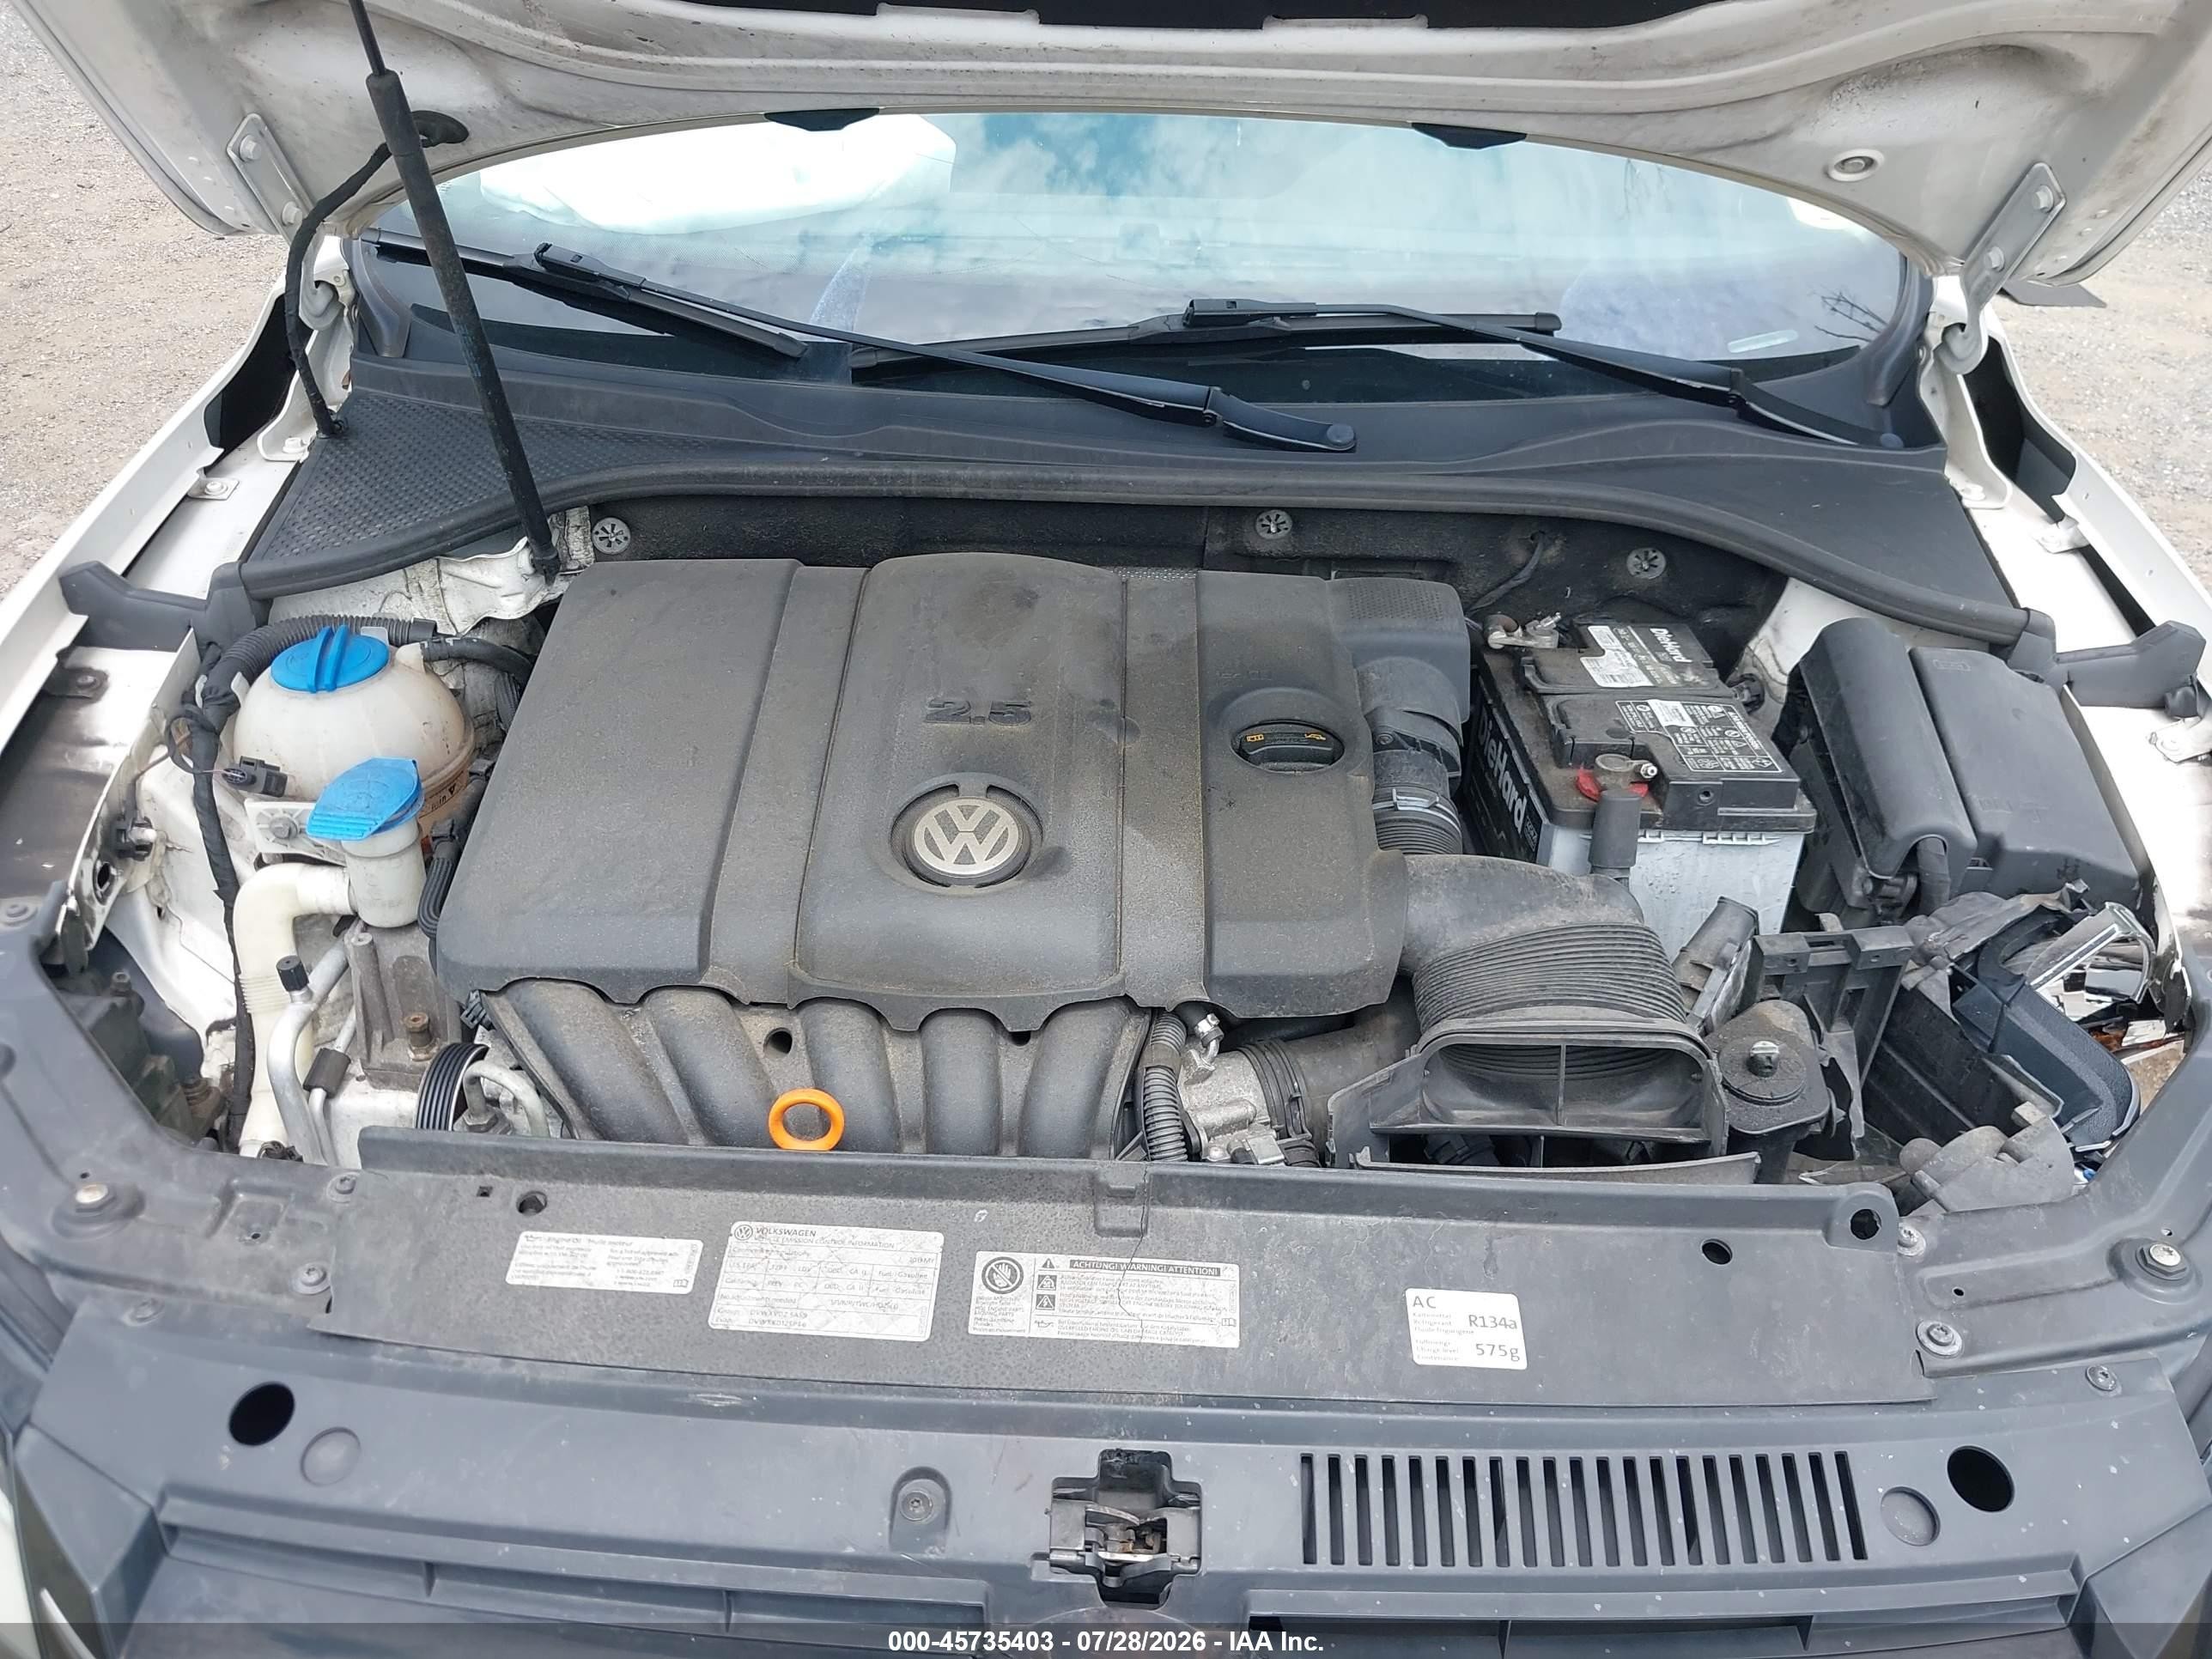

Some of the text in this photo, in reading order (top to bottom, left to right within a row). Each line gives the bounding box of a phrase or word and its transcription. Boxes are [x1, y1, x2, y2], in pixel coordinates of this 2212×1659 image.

[1650, 628, 1692, 662] DieHard
[926, 700, 1031, 726] 2.5
[1478, 711, 1528, 836] DieHard
[756, 1226, 817, 1237] VOLKSWAGEN
[1073, 1261, 1218, 1276] ACHTUNG! WARNING! ATTENTION!
[1413, 1295, 1436, 1309] AC
[1468, 1314, 1518, 1330] R134a
[1475, 1343, 1520, 1363] 575g
